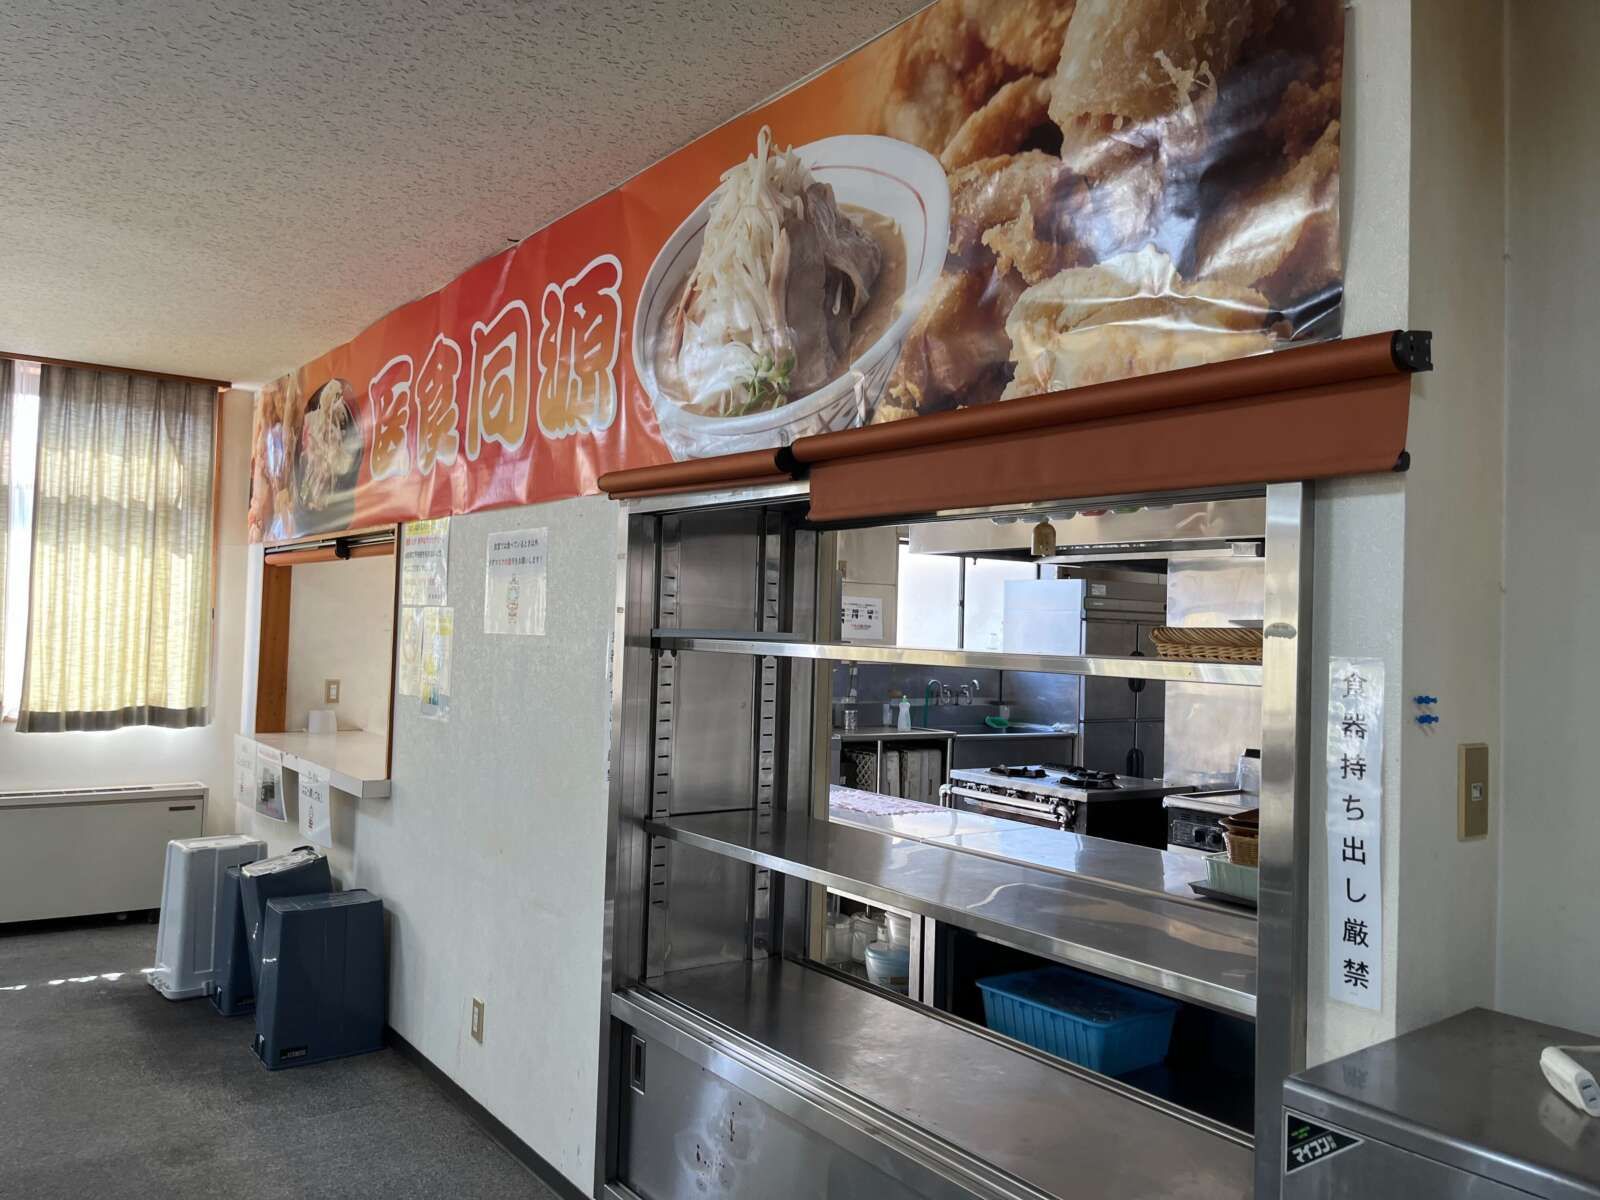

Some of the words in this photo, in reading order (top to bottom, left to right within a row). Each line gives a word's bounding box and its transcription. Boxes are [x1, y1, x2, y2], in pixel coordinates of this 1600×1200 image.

[369, 254, 622, 480] 医食同源
[1340, 672, 1370, 990] 食器持ち出し厳禁
